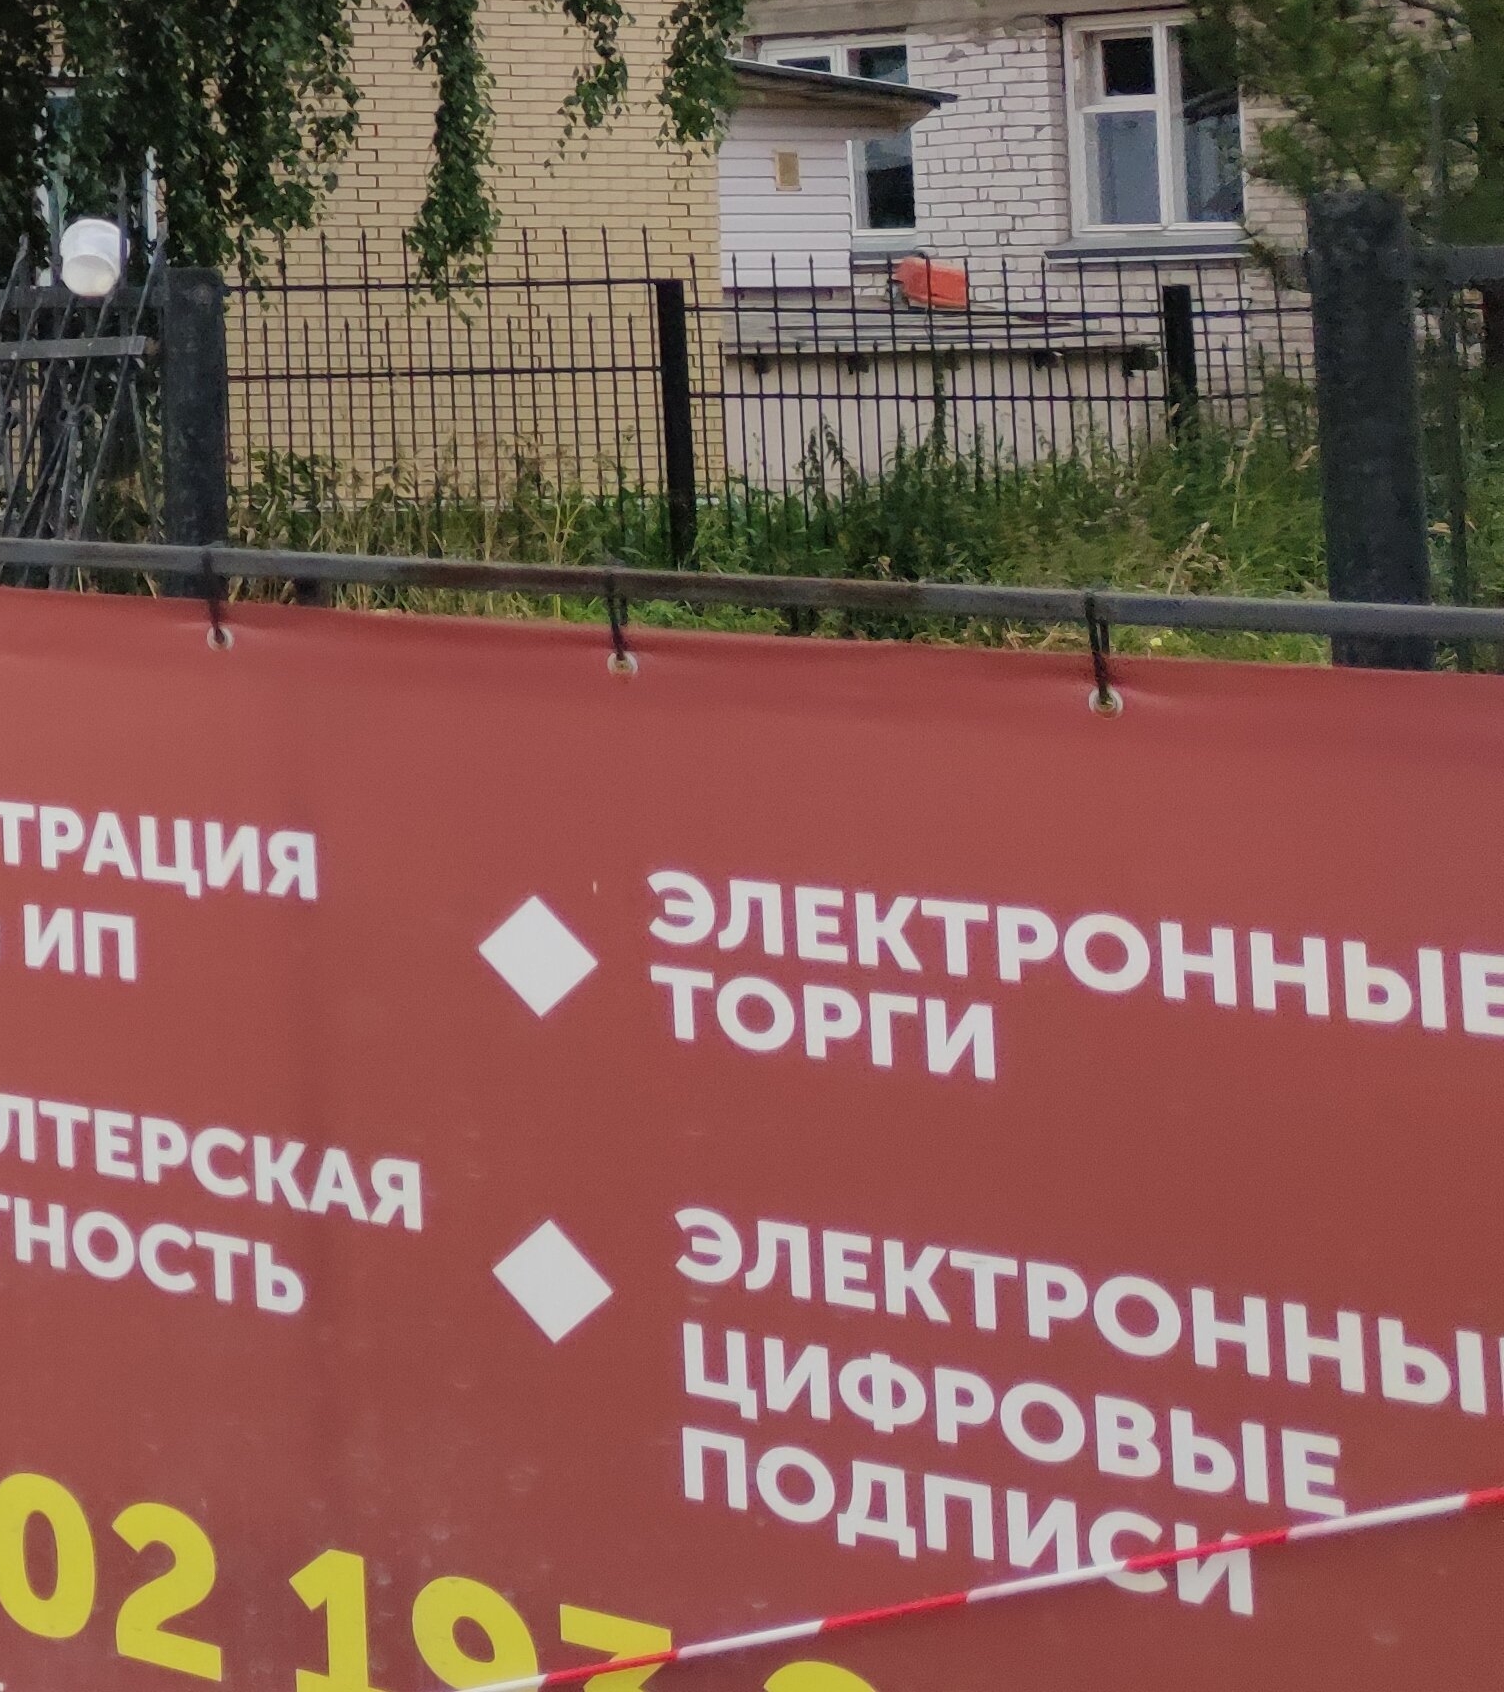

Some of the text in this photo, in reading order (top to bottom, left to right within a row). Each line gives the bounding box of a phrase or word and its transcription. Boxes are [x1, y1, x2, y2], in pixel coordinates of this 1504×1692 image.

[22, 903, 138, 982] ИП
[646, 869, 1504, 1037] ЭЛЕКТРОННЫЕ
[648, 964, 996, 1081] ТОРГИ
[673, 1207, 1504, 1416] ЭЛЕКТРОННЫ
[683, 1322, 1347, 1518] ЦИФРОВЫЕ
[682, 1426, 1254, 1616] ПОДПИСИ
